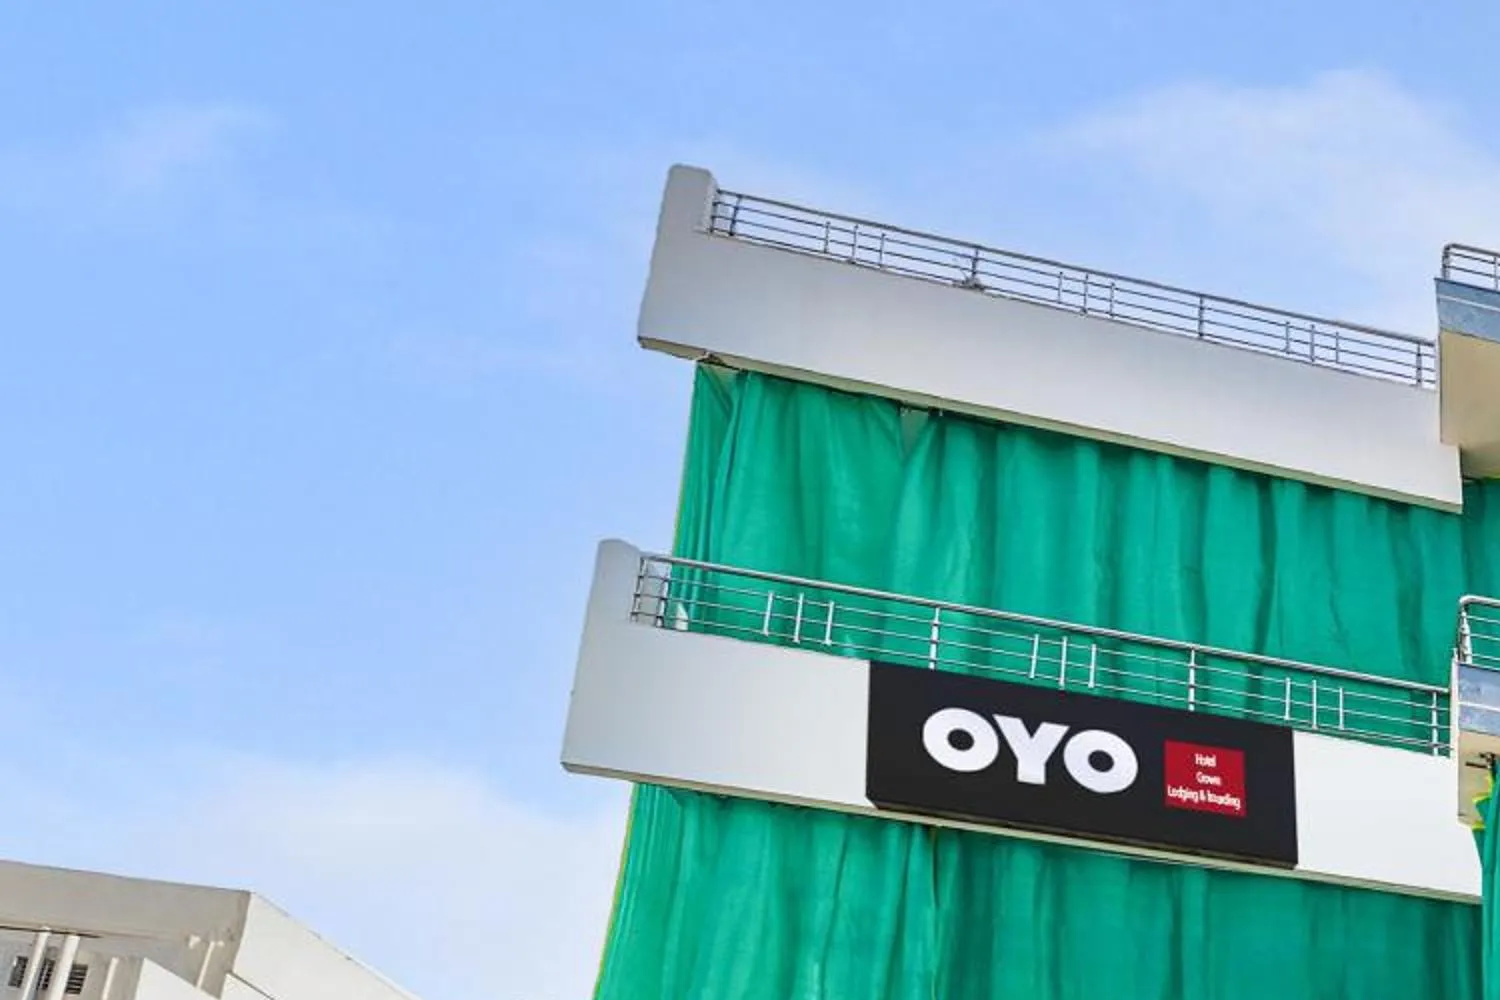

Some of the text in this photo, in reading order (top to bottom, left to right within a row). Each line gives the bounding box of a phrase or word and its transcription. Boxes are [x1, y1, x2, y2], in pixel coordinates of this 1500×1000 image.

[922, 707, 1139, 794] OYO
[1195, 752, 1217, 768] Hotel
[1196, 771, 1222, 786] Crown
[1167, 785, 1198, 804] Lodging
